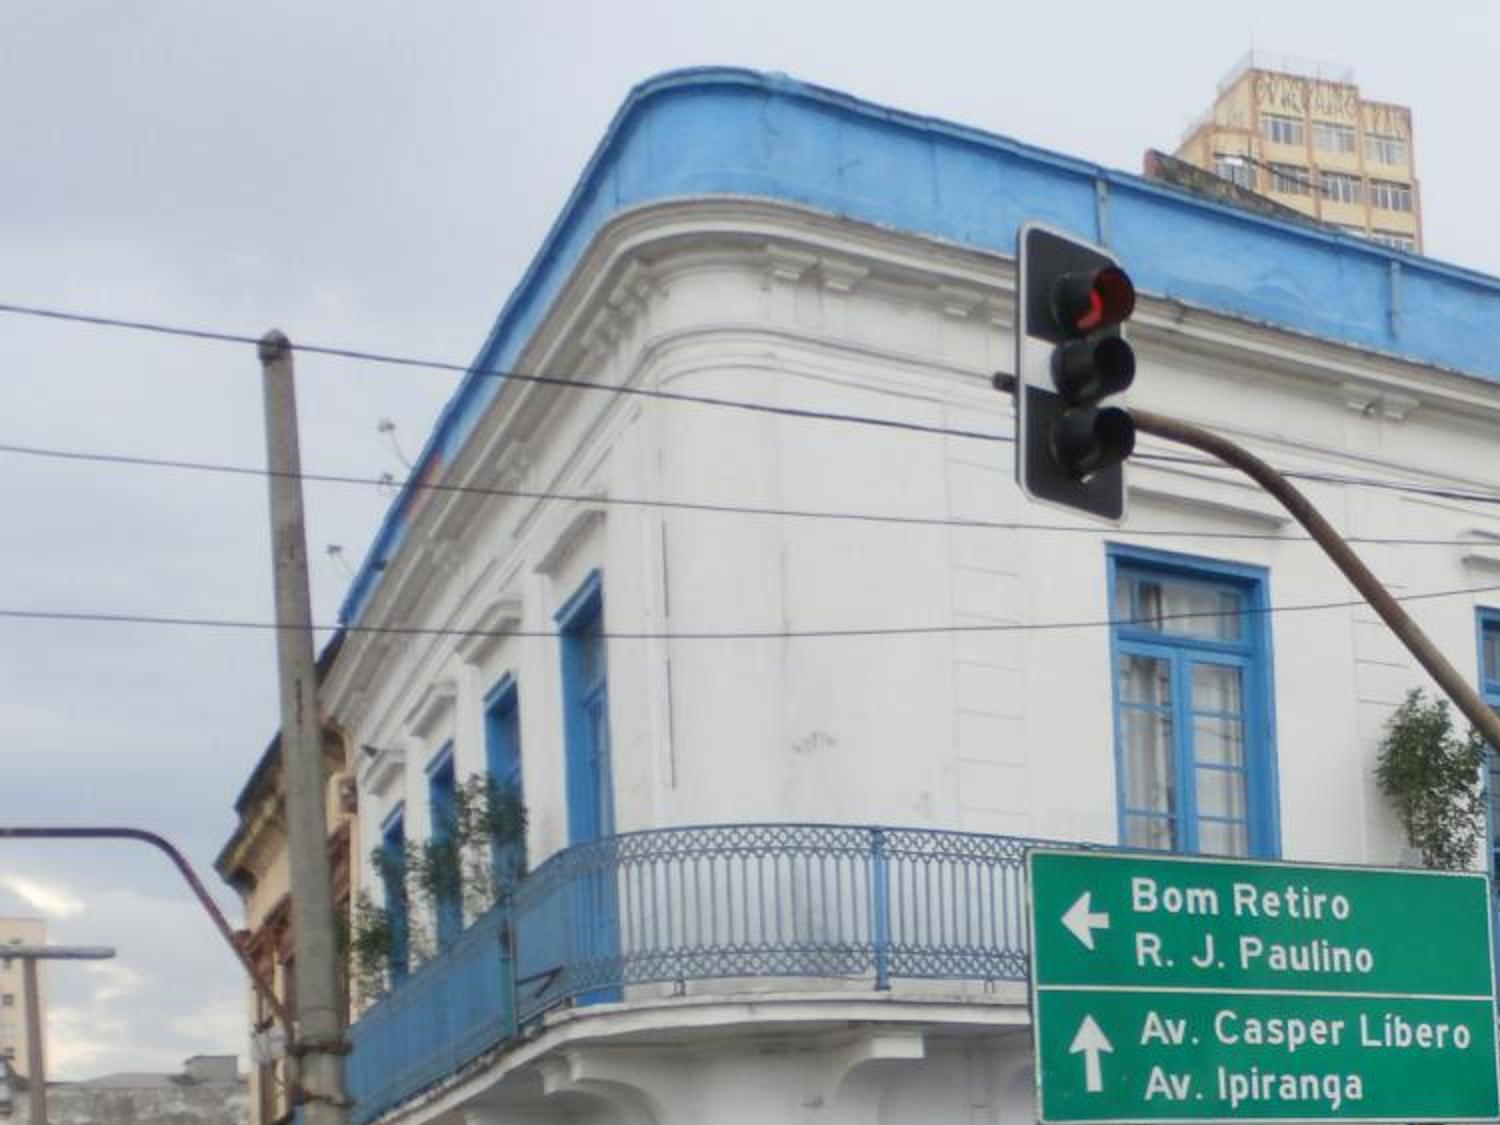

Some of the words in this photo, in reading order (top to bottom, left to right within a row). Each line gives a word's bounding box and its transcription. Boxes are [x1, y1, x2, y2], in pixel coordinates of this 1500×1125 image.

[1132, 877, 1219, 916] Bom
[1233, 882, 1350, 920] Retiro
[1135, 932, 1173, 967] R.
[1192, 934, 1224, 969] J.
[1239, 936, 1374, 974] Paulino
[1140, 1010, 1199, 1045] Av.
[1214, 1010, 1345, 1053] Casper
[1360, 1013, 1471, 1050] Líbero
[1144, 1066, 1203, 1101] Av.
[1218, 1066, 1363, 1111] Ipiranga
